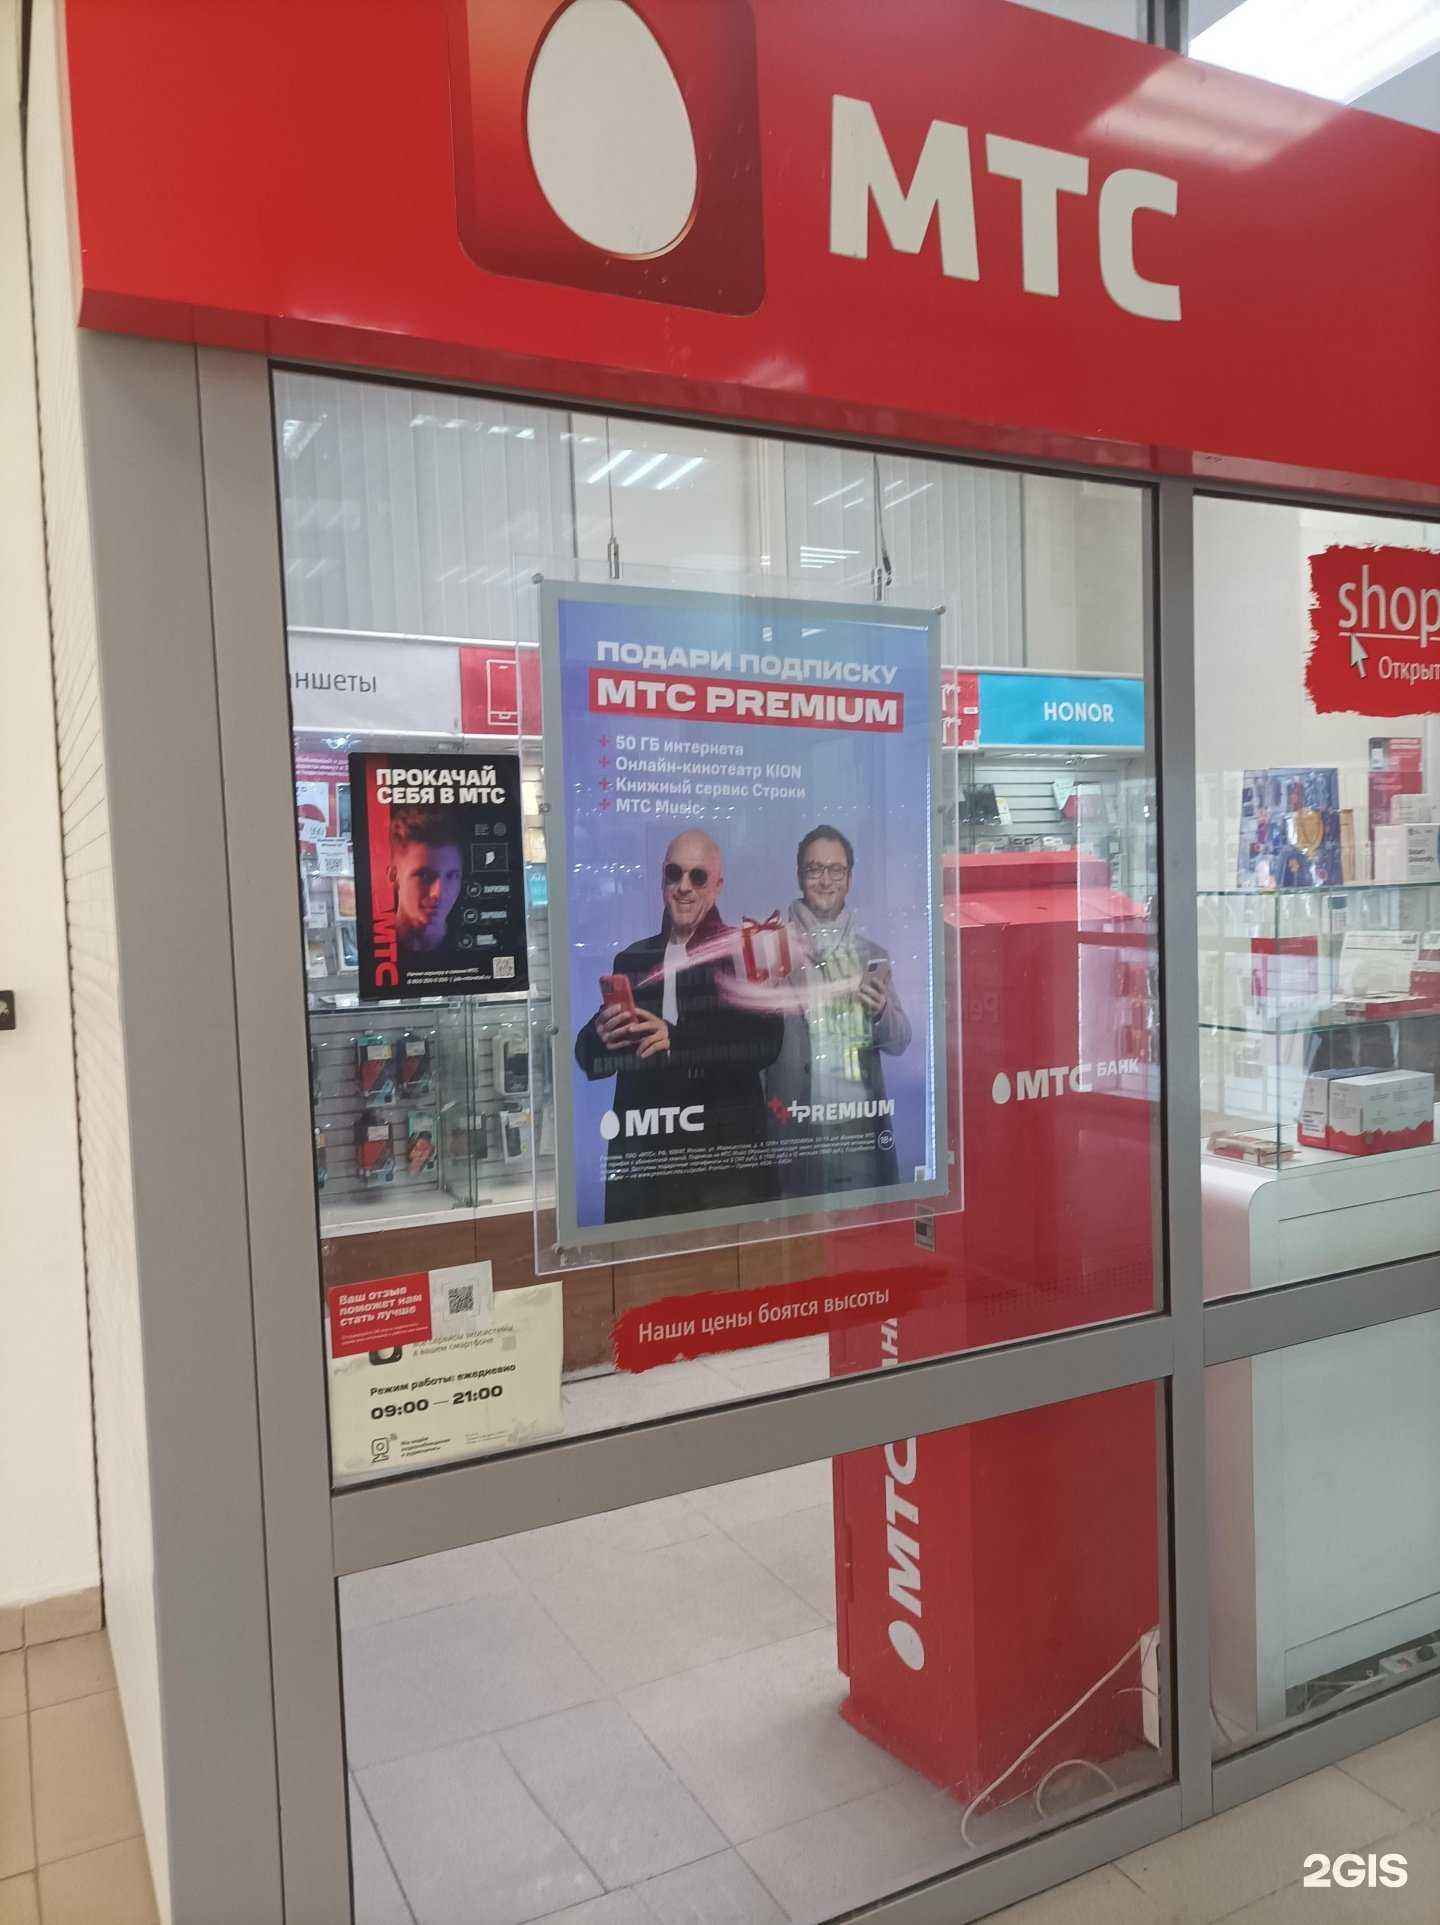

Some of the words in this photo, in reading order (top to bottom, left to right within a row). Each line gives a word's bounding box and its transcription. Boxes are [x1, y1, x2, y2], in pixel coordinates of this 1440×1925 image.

[829, 94, 1182, 322] МТС
[1337, 564, 1440, 648] shop
[597, 640, 732, 672] ПОДАРИ
[740, 654, 898, 685] ПОДПИСКУ
[289, 671, 377, 693] ншеты
[597, 678, 697, 711] МТС
[707, 687, 897, 725] PREMIUM
[1044, 701, 1115, 723] HONOR
[616, 736, 637, 750] 50
[640, 737, 660, 751] ГБ
[664, 740, 744, 757] интернета
[376, 764, 496, 786] ПРОКАЧАЙ
[616, 756, 762, 780] Онлайн-кинотеатр
[766, 764, 802, 780] KION
[377, 787, 435, 805] СЕБЯ
[440, 788, 455, 804] В
[459, 788, 506, 805] МТС
[616, 777, 691, 795] Книжный
[695, 782, 749, 799] сервис
[752, 783, 806, 801] Строки
[616, 799, 651, 813] МТС
[655, 800, 701, 815] Music
[373, 906, 398, 986] МТС
[1016, 1064, 1092, 1100] МТС
[1096, 1058, 1139, 1077] БАНК
[625, 1104, 705, 1137] МТС
[339, 1292, 366, 1305] Ваш
[340, 1314, 375, 1327] стать
[638, 1320, 695, 1344] Наши
[701, 1311, 753, 1335] цены
[758, 1299, 818, 1324] боятся
[823, 1288, 890, 1313] высоты
[370, 1382, 409, 1396] Режим
[456, 1364, 516, 1380] ежедневно
[371, 1398, 430, 1420] 09:00
[452, 1385, 503, 1405] 21:00
[884, 1437, 922, 1618] МТС
